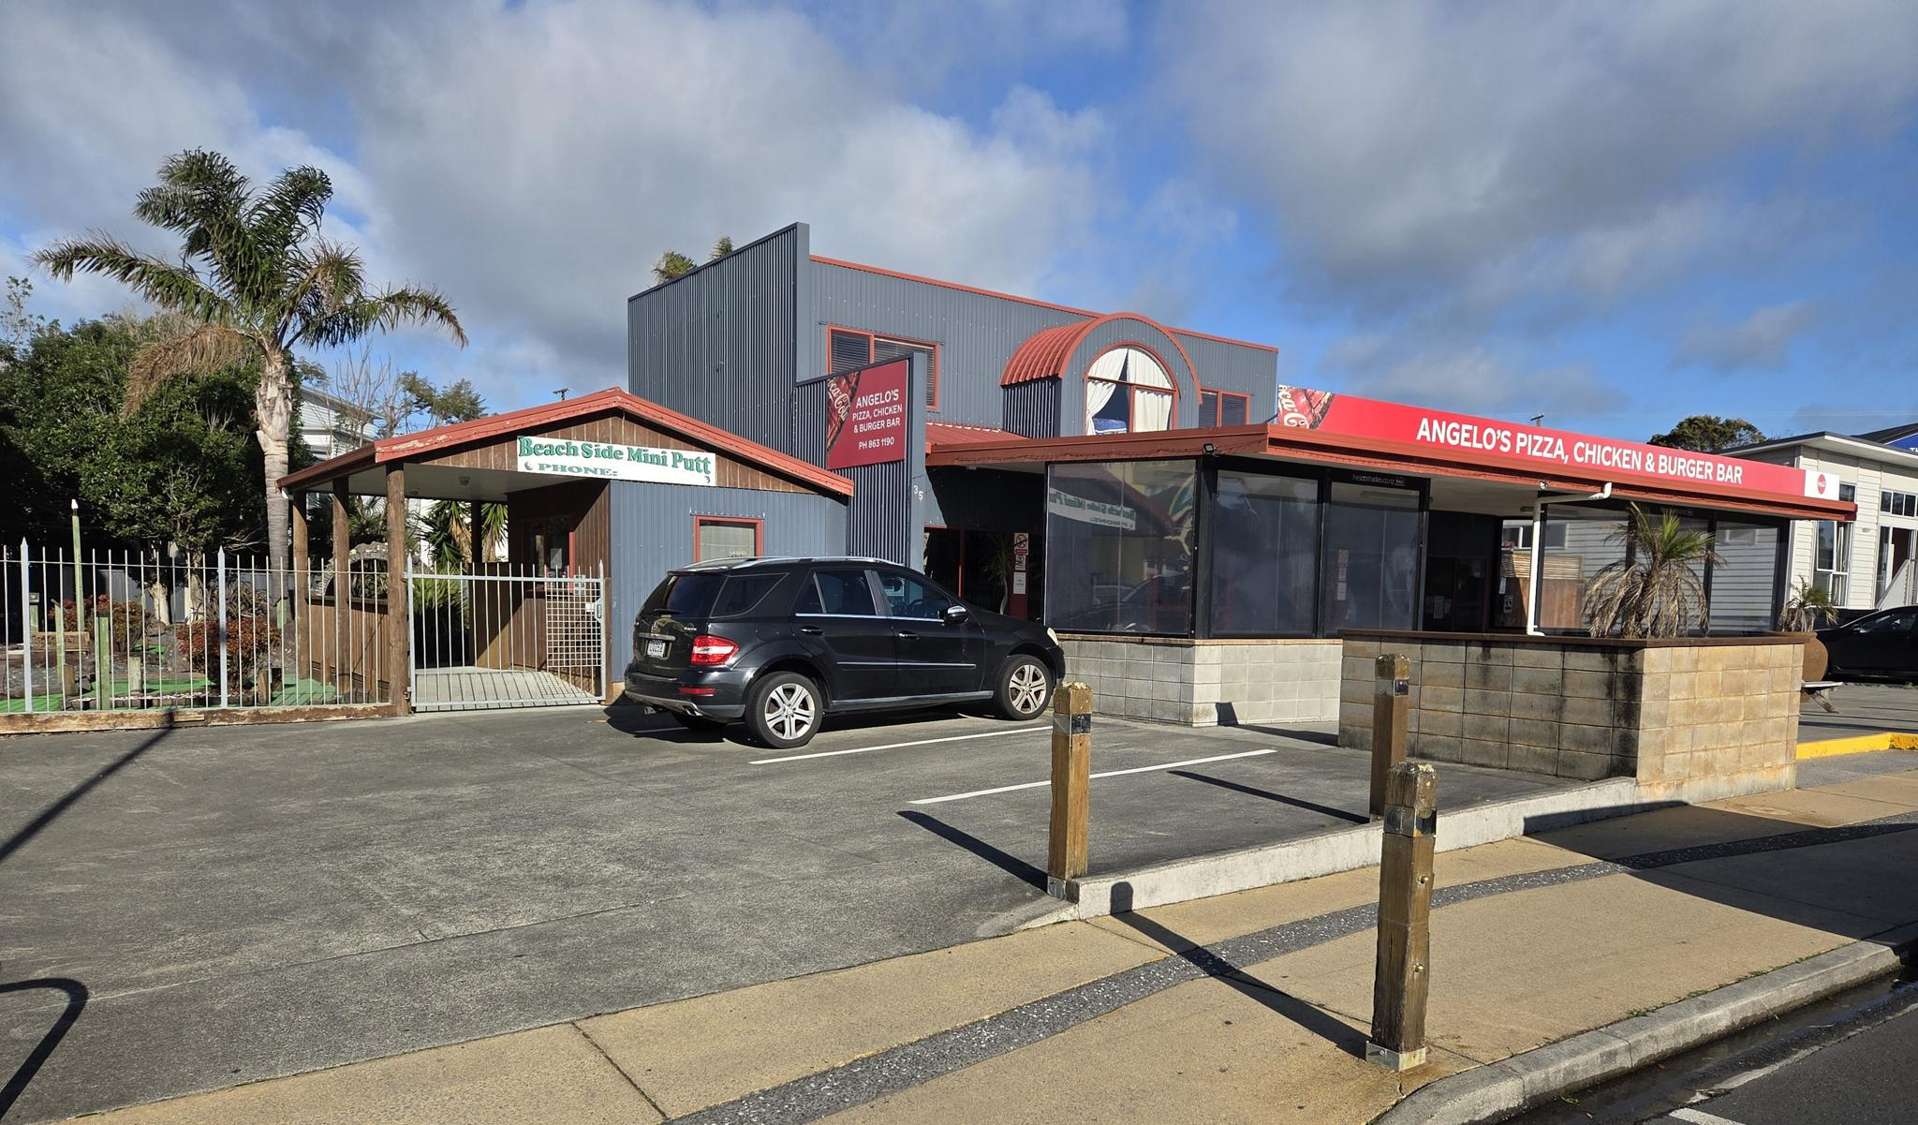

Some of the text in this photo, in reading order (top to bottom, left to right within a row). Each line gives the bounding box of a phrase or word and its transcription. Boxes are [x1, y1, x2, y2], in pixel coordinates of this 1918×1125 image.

[856, 389, 899, 409] ANGELO'S
[852, 404, 903, 421] PIZZA, CHICKEN
[853, 418, 900, 433] & BURGER BAR
[858, 441, 868, 450] PH
[868, 438, 880, 449] 863
[1416, 417, 1743, 484] ANGELO'S PIZZA, CHICKEN & BURGER BAR
[519, 437, 711, 474] Beach Side Mini Putt
[538, 463, 618, 476] PHONE:
